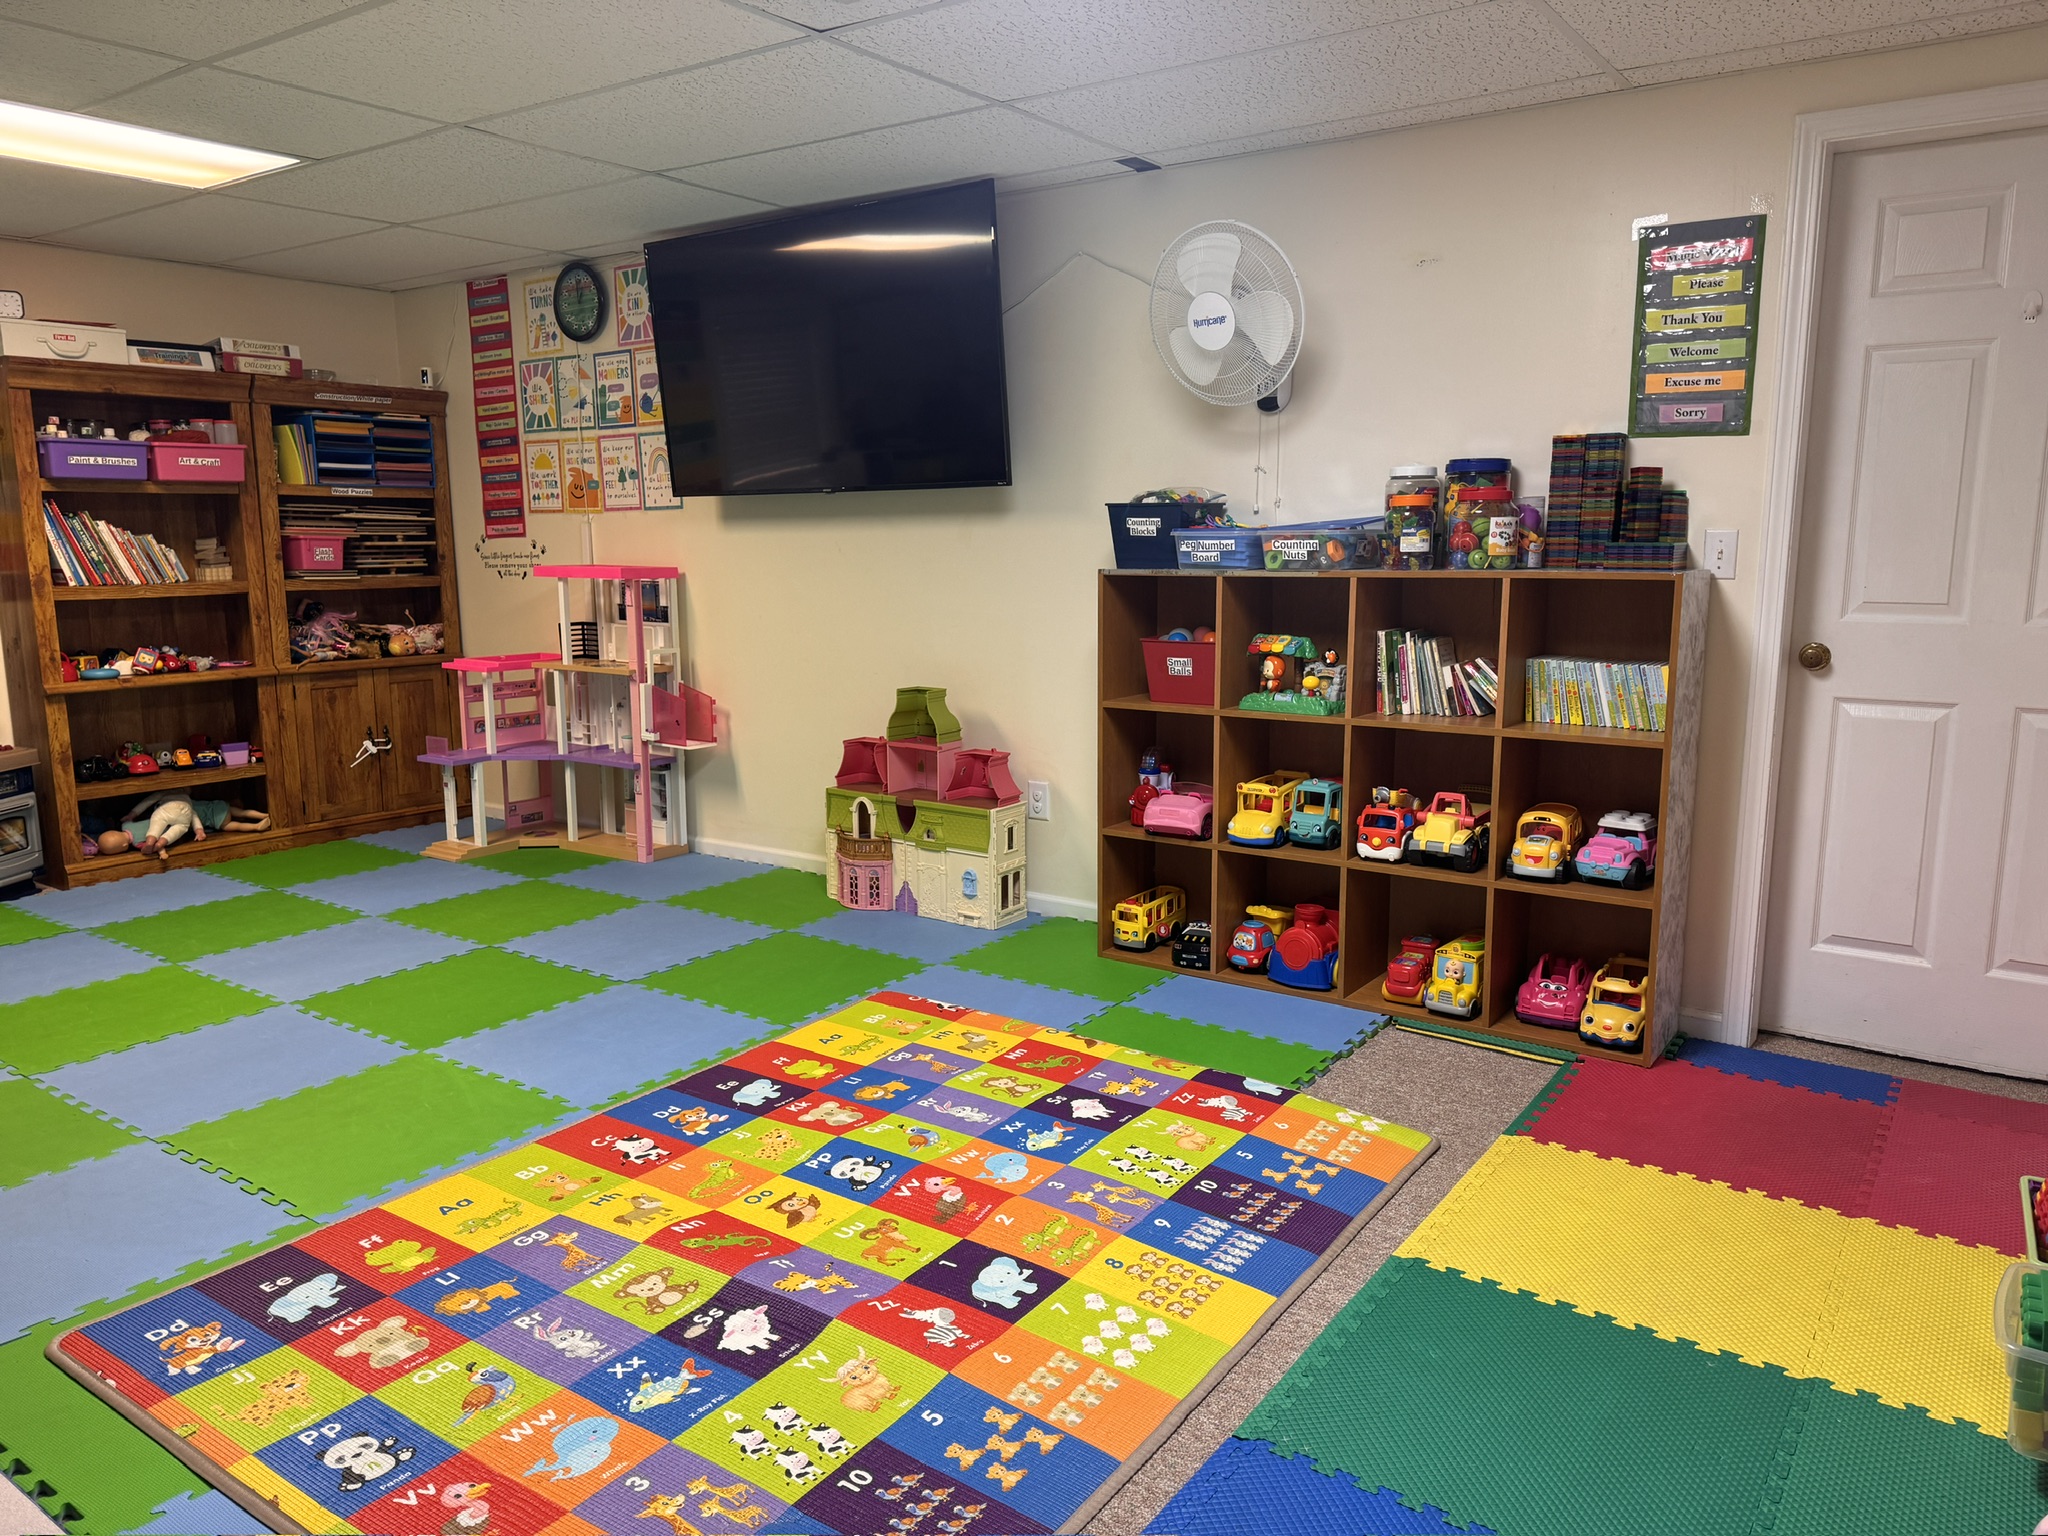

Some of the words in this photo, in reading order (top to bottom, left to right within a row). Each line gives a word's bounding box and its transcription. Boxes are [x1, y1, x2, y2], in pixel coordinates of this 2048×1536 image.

[1690, 278, 1724, 290] Please
[530, 294, 552, 310] TURNS
[1192, 314, 1227, 328] Hurricane
[1661, 312, 1698, 326] Thank
[1702, 312, 1723, 324] You
[154, 351, 188, 360] Trainings
[1670, 344, 1719, 357] Welcome
[1664, 376, 1702, 388] Excuse
[1704, 377, 1722, 386] me
[1674, 406, 1706, 420] Sorry
[68, 456, 92, 464] Paint
[100, 458, 137, 466] Brushes
[179, 456, 192, 464] Art
[192, 458, 200, 466] &
[200, 458, 220, 466] Craft
[350, 488, 372, 496] Puzzles
[1126, 518, 1161, 528] Counting
[1130, 528, 1156, 536] Blocks
[314, 548, 332, 556] Flash
[1180, 540, 1196, 552] Peg
[1198, 540, 1235, 550] Number
[1272, 540, 1318, 552] Counting
[314, 554, 334, 562] Cards
[1192, 553, 1220, 562] Board
[1283, 551, 1306, 560] Nuts
[1167, 657, 1192, 668] Small
[1168, 666, 1192, 676] Balls
[863, 1012, 886, 1024] Bb
[818, 1032, 843, 1044] Aa
[931, 1029, 954, 1040] Hh
[888, 1051, 912, 1063] Gg
[716, 1080, 740, 1091] Ee
[1047, 1092, 1068, 1106] Ss
[1172, 1091, 1196, 1105] Zz
[652, 1105, 682, 1119] Dd
[786, 1101, 812, 1113] Kk
[863, 1120, 894, 1134] Qq
[1000, 1120, 1026, 1132] Xx
[1273, 1121, 1290, 1130] 6
[590, 1134, 618, 1149] Cc
[732, 1130, 752, 1141] Jj
[946, 1148, 980, 1166] Ww
[1096, 1148, 1111, 1158] 4
[1236, 1150, 1253, 1160] 5
[804, 1151, 832, 1170] Pp
[514, 1162, 550, 1182] Bb
[894, 1176, 921, 1199] Vv
[1047, 1180, 1066, 1190] 3
[1194, 1180, 1218, 1194] 10
[589, 1190, 624, 1208] Hh
[744, 1188, 774, 1206] Oo
[438, 1196, 475, 1217] Aa
[670, 1217, 707, 1235] Nn
[994, 1213, 1015, 1228] 2
[1154, 1218, 1172, 1229] 9
[833, 1220, 866, 1240] Uu
[512, 1228, 550, 1248] Gg
[768, 1257, 796, 1270] Tt
[938, 1259, 957, 1268] 1
[1105, 1258, 1124, 1270] 8
[590, 1260, 636, 1291] Mm
[258, 1275, 294, 1294] Ee
[504, 1306, 522, 1317] Lion
[867, 1298, 900, 1312] Zz
[1050, 1302, 1070, 1315] 7
[317, 1306, 354, 1326] Elephant
[512, 1310, 546, 1330] Rr
[692, 1306, 726, 1327] Ss
[144, 1318, 191, 1342] Dd
[329, 1314, 371, 1337] Kk
[778, 1342, 802, 1360] Sheep
[992, 1351, 1013, 1364] 6
[403, 1354, 430, 1371] Koala
[794, 1350, 830, 1370] Yy
[411, 1360, 461, 1385] Qq
[606, 1356, 647, 1380] Xx
[232, 1368, 257, 1386] Jj
[288, 1412, 320, 1432] Jaguar
[723, 1410, 744, 1425] 4
[920, 1409, 944, 1427] 5
[500, 1408, 559, 1443] Ww
[297, 1421, 343, 1446] Pp
[379, 1470, 412, 1492] Panda
[624, 1475, 651, 1492] 3
[836, 1468, 874, 1493] 10
[392, 1482, 438, 1507] Vv
